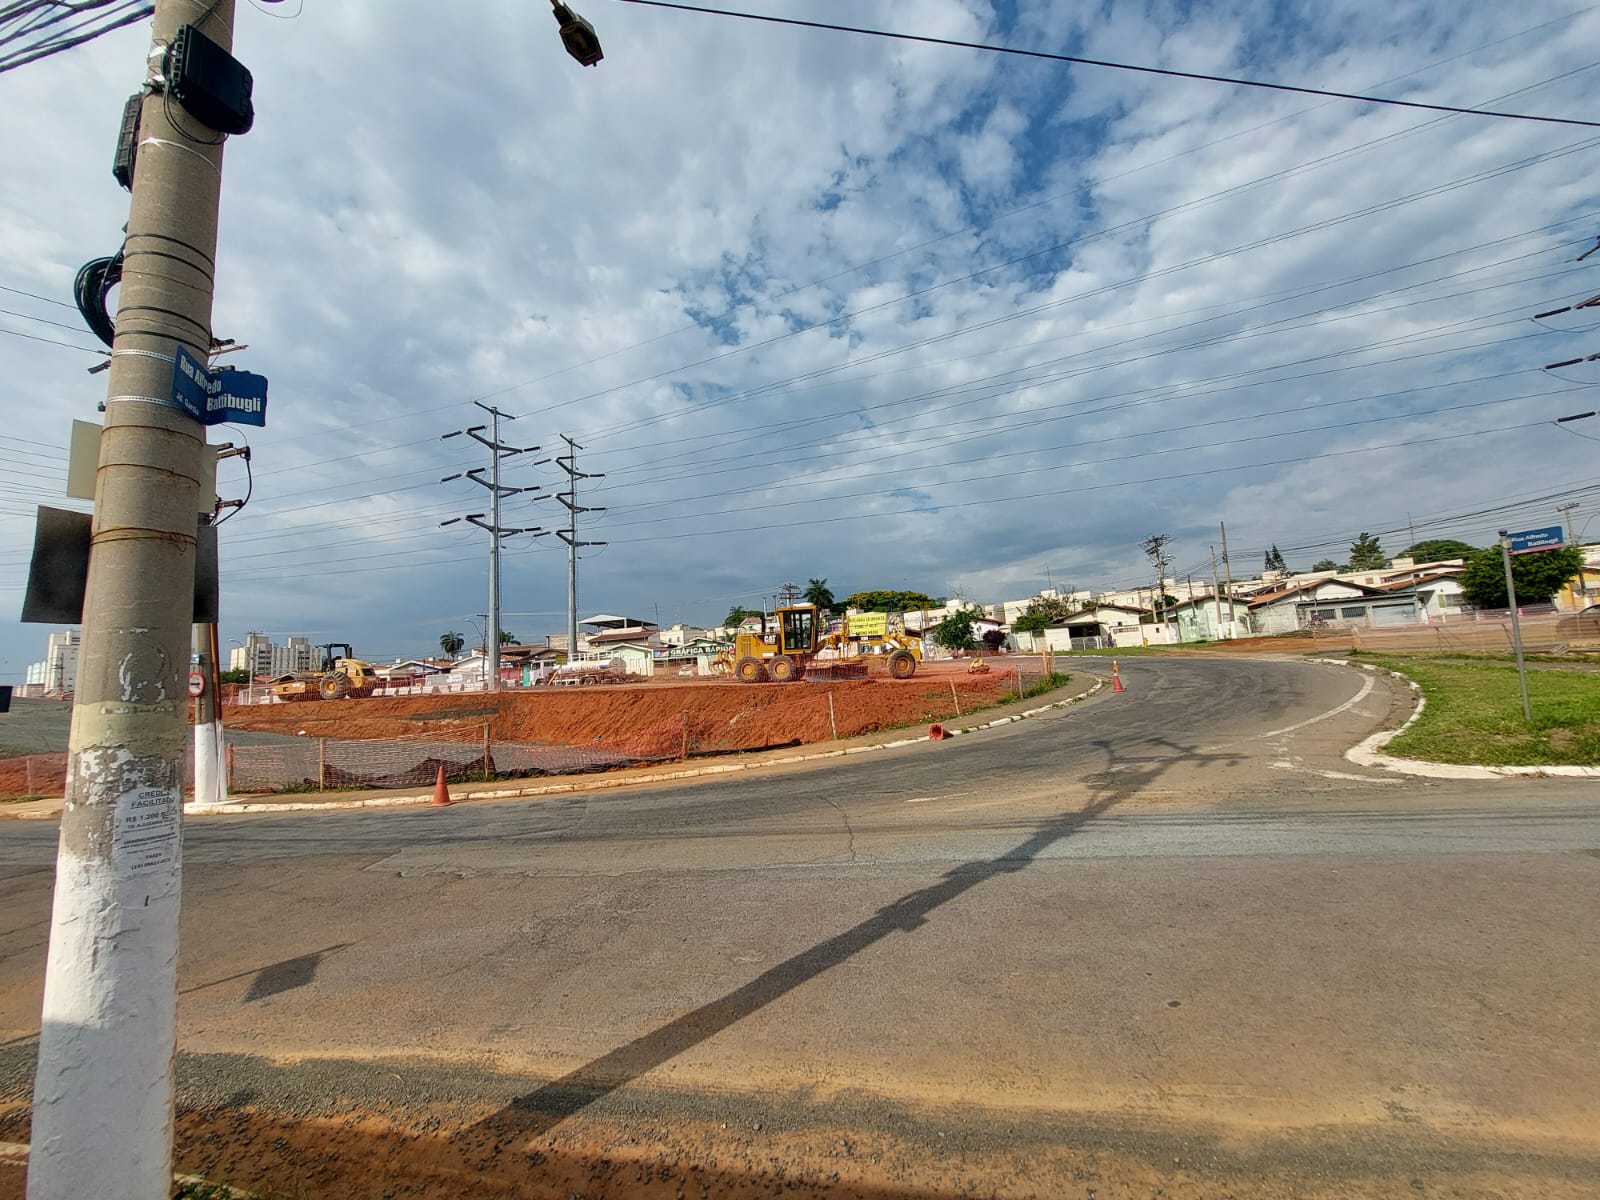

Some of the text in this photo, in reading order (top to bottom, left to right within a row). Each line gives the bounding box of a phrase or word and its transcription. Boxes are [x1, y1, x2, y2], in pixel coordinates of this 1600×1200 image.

[180, 354, 222, 394] Rua Alfredo
[206, 393, 261, 413] Battibugli
[1525, 532, 1549, 541] Alfredo
[763, 634, 776, 644] CAT
